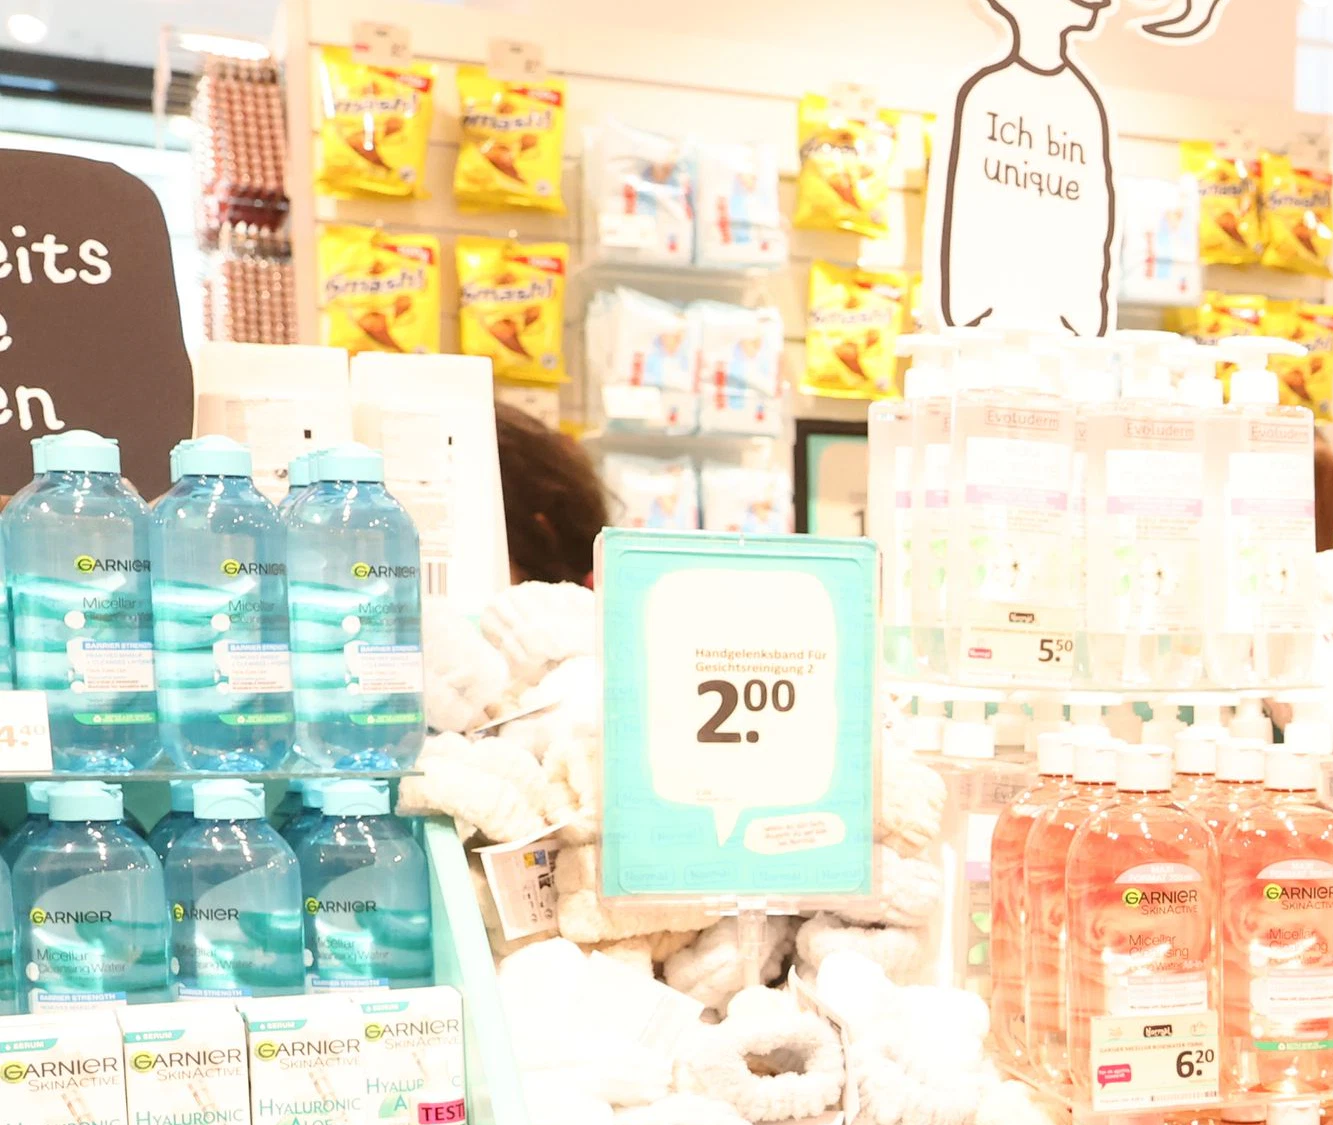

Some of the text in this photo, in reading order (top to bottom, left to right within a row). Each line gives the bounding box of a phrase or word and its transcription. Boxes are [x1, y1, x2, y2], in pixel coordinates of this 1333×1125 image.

[987, 111, 1086, 165] Ich bin
[984, 156, 1080, 201] unique
[1037, 638, 1073, 662] 5.50
[697, 679, 796, 744] 2.00
[31, 909, 112, 924] GARNIER
[134, 1049, 242, 1071] GARNIER
[258, 1039, 360, 1058] GARNIER
[3, 1057, 118, 1081] GARNIER
[1176, 1049, 1215, 1078] 6.20
[259, 1098, 361, 1116] HYALURONIC
